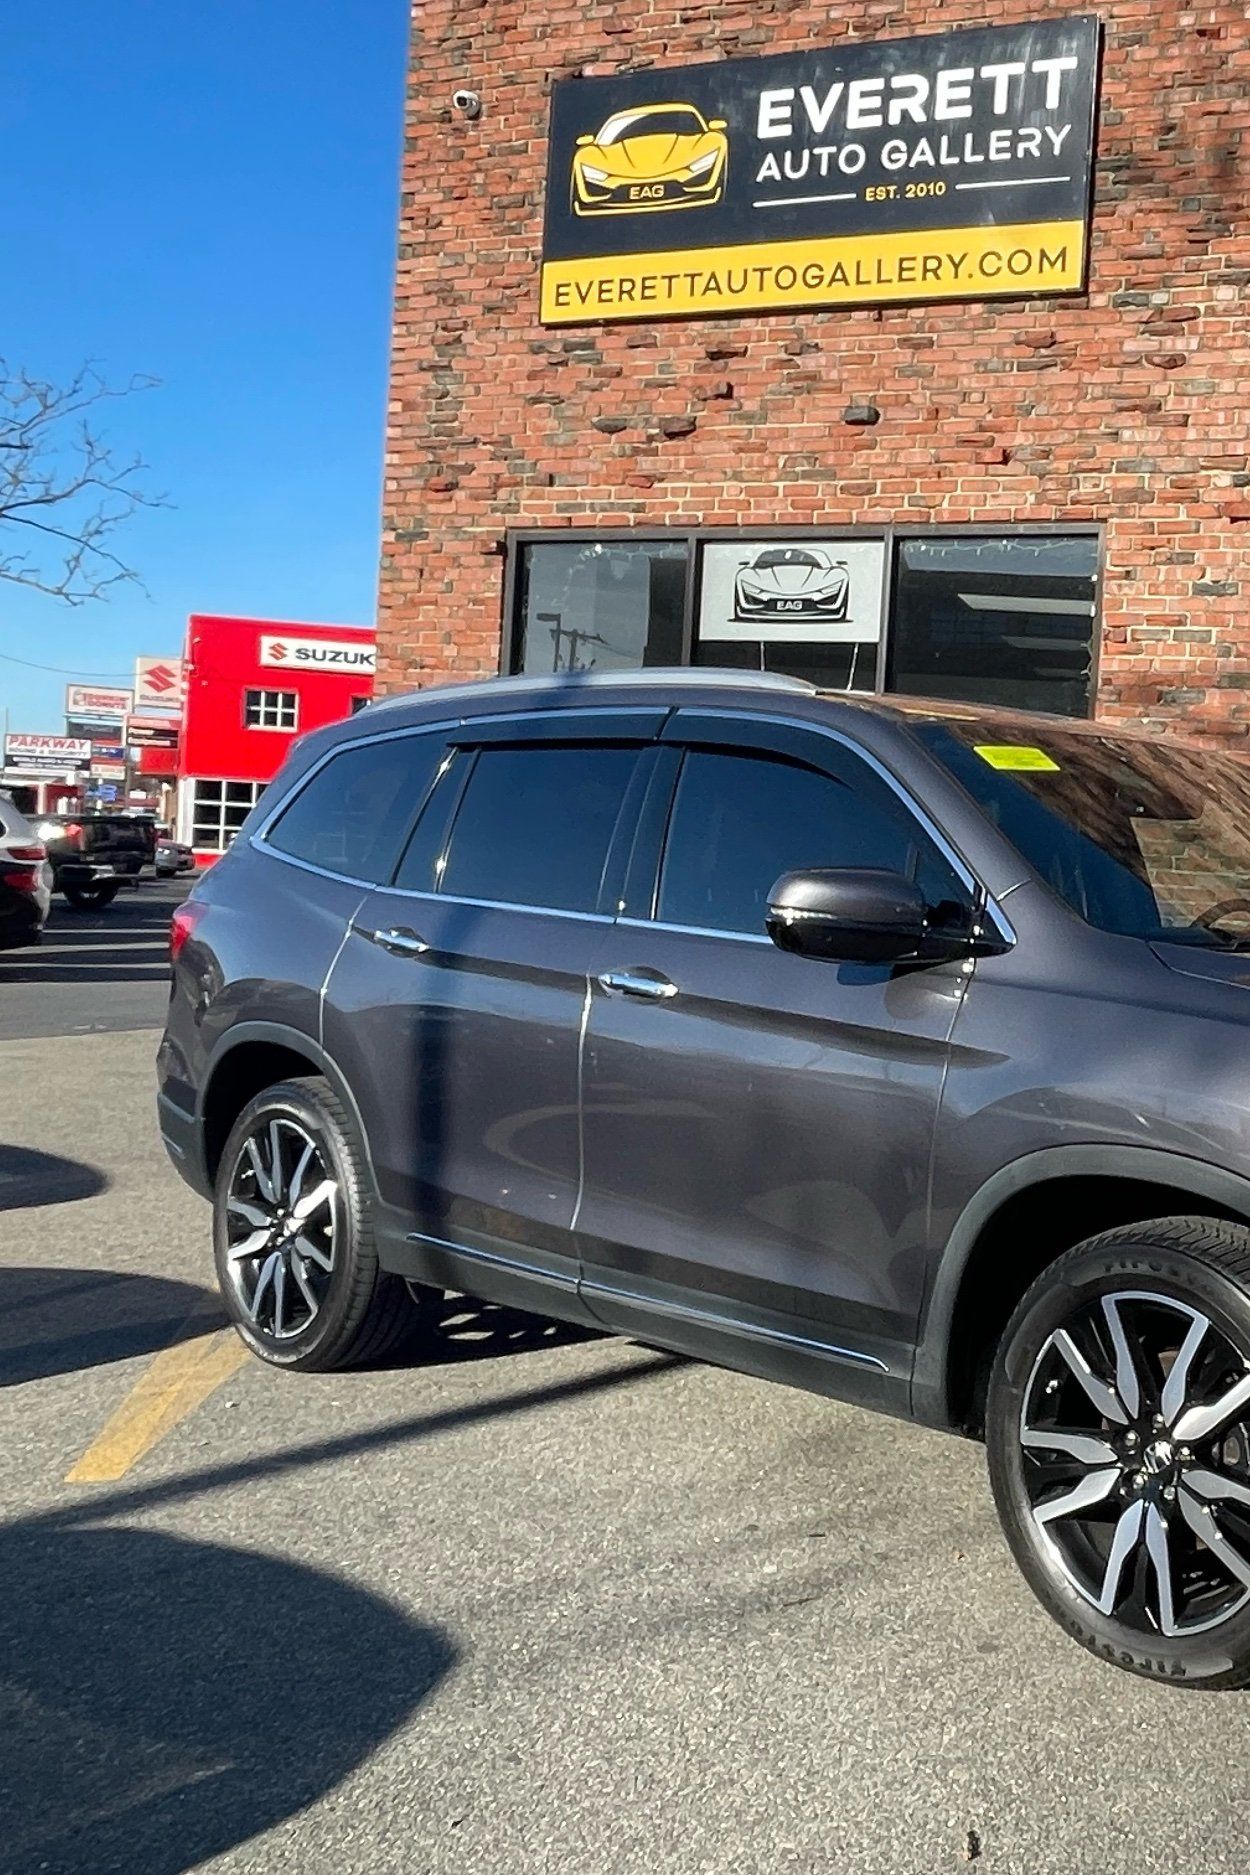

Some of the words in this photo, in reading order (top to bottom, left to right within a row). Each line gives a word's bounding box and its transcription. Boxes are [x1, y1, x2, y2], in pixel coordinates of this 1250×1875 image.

[757, 57, 1078, 139] EVERETT
[755, 143, 866, 183] AUTO
[880, 124, 1072, 170] GALLERY
[628, 184, 665, 200] EAG
[865, 184, 900, 201] EST.
[905, 181, 947, 198] 2010
[554, 245, 1069, 308] EVERETTAUTOGALLERY.COM
[776, 600, 803, 611] EAG
[295, 647, 375, 666] SUZUK
[9, 735, 87, 749] PARKWAY
